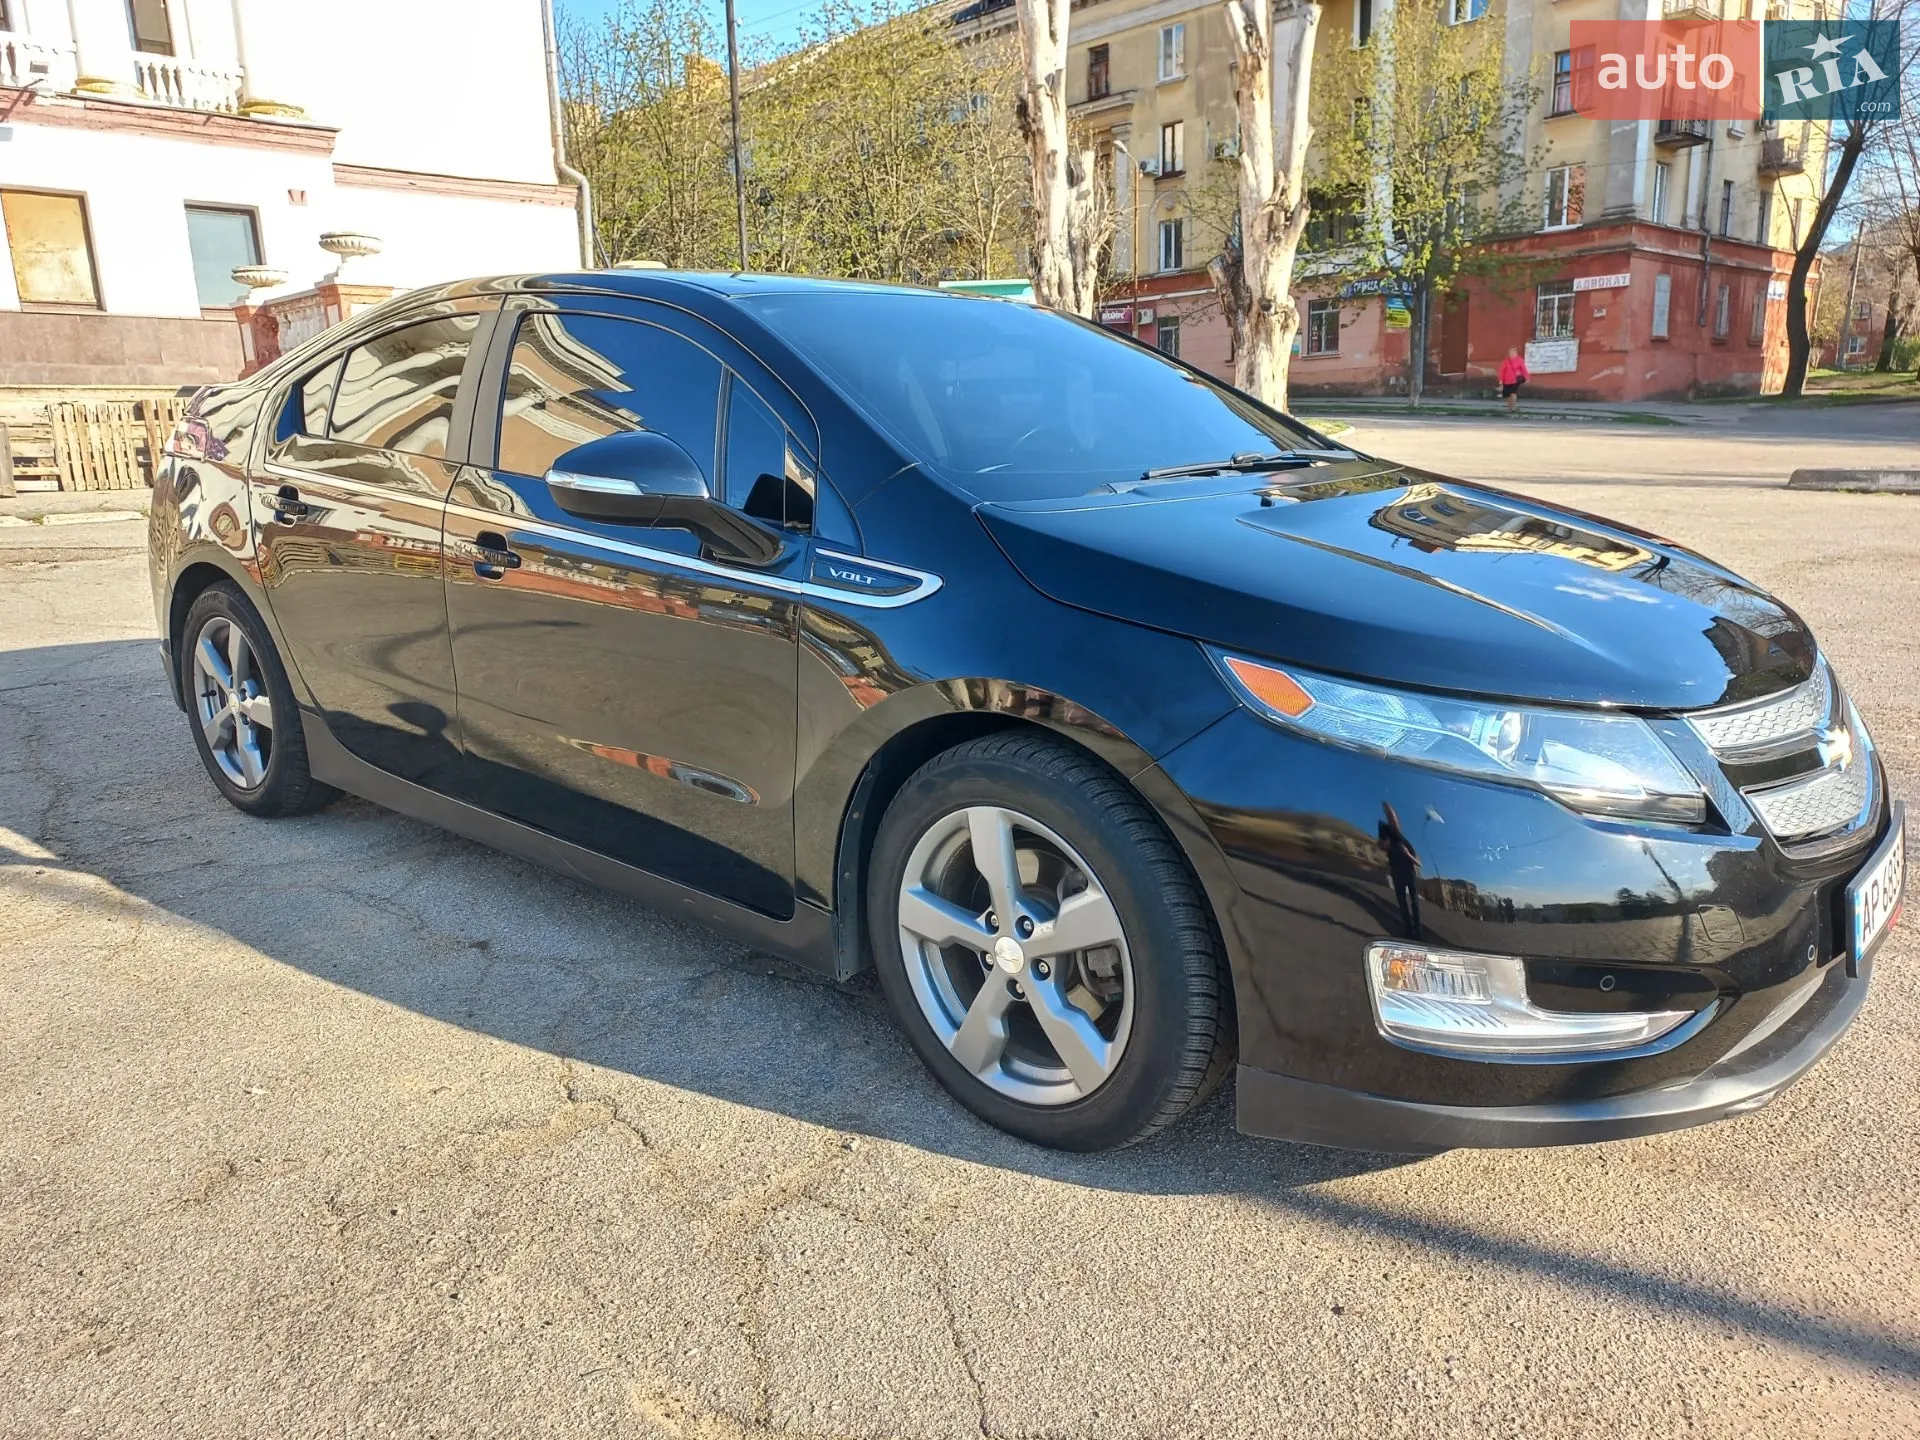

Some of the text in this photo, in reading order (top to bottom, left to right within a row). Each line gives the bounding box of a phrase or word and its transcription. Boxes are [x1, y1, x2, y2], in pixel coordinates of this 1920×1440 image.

[1576, 275, 1628, 289] АДВОКАТ
[829, 566, 876, 585] VOLT
[1862, 878, 1880, 943] AP
